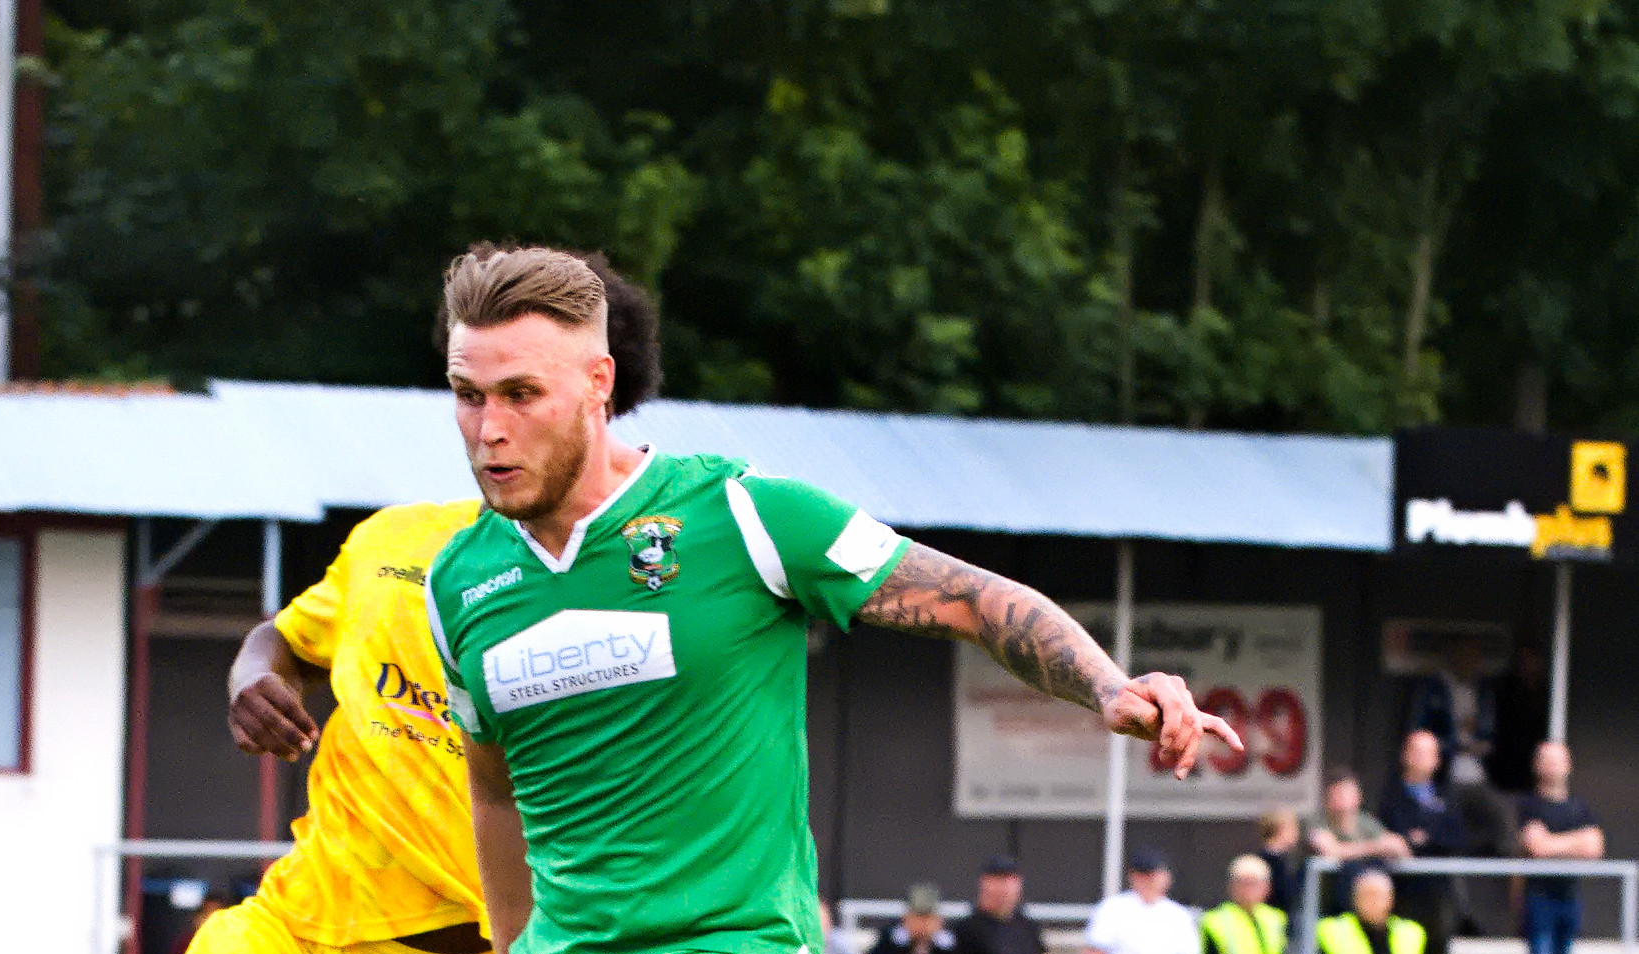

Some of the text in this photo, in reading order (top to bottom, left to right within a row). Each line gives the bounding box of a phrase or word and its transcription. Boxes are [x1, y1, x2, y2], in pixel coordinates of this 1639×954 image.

[461, 566, 523, 608] macron
[493, 630, 657, 686] Liberty
[509, 662, 640, 702] STEEL STRUCTURES
[370, 720, 403, 739] The
[446, 737, 465, 760] Sp
